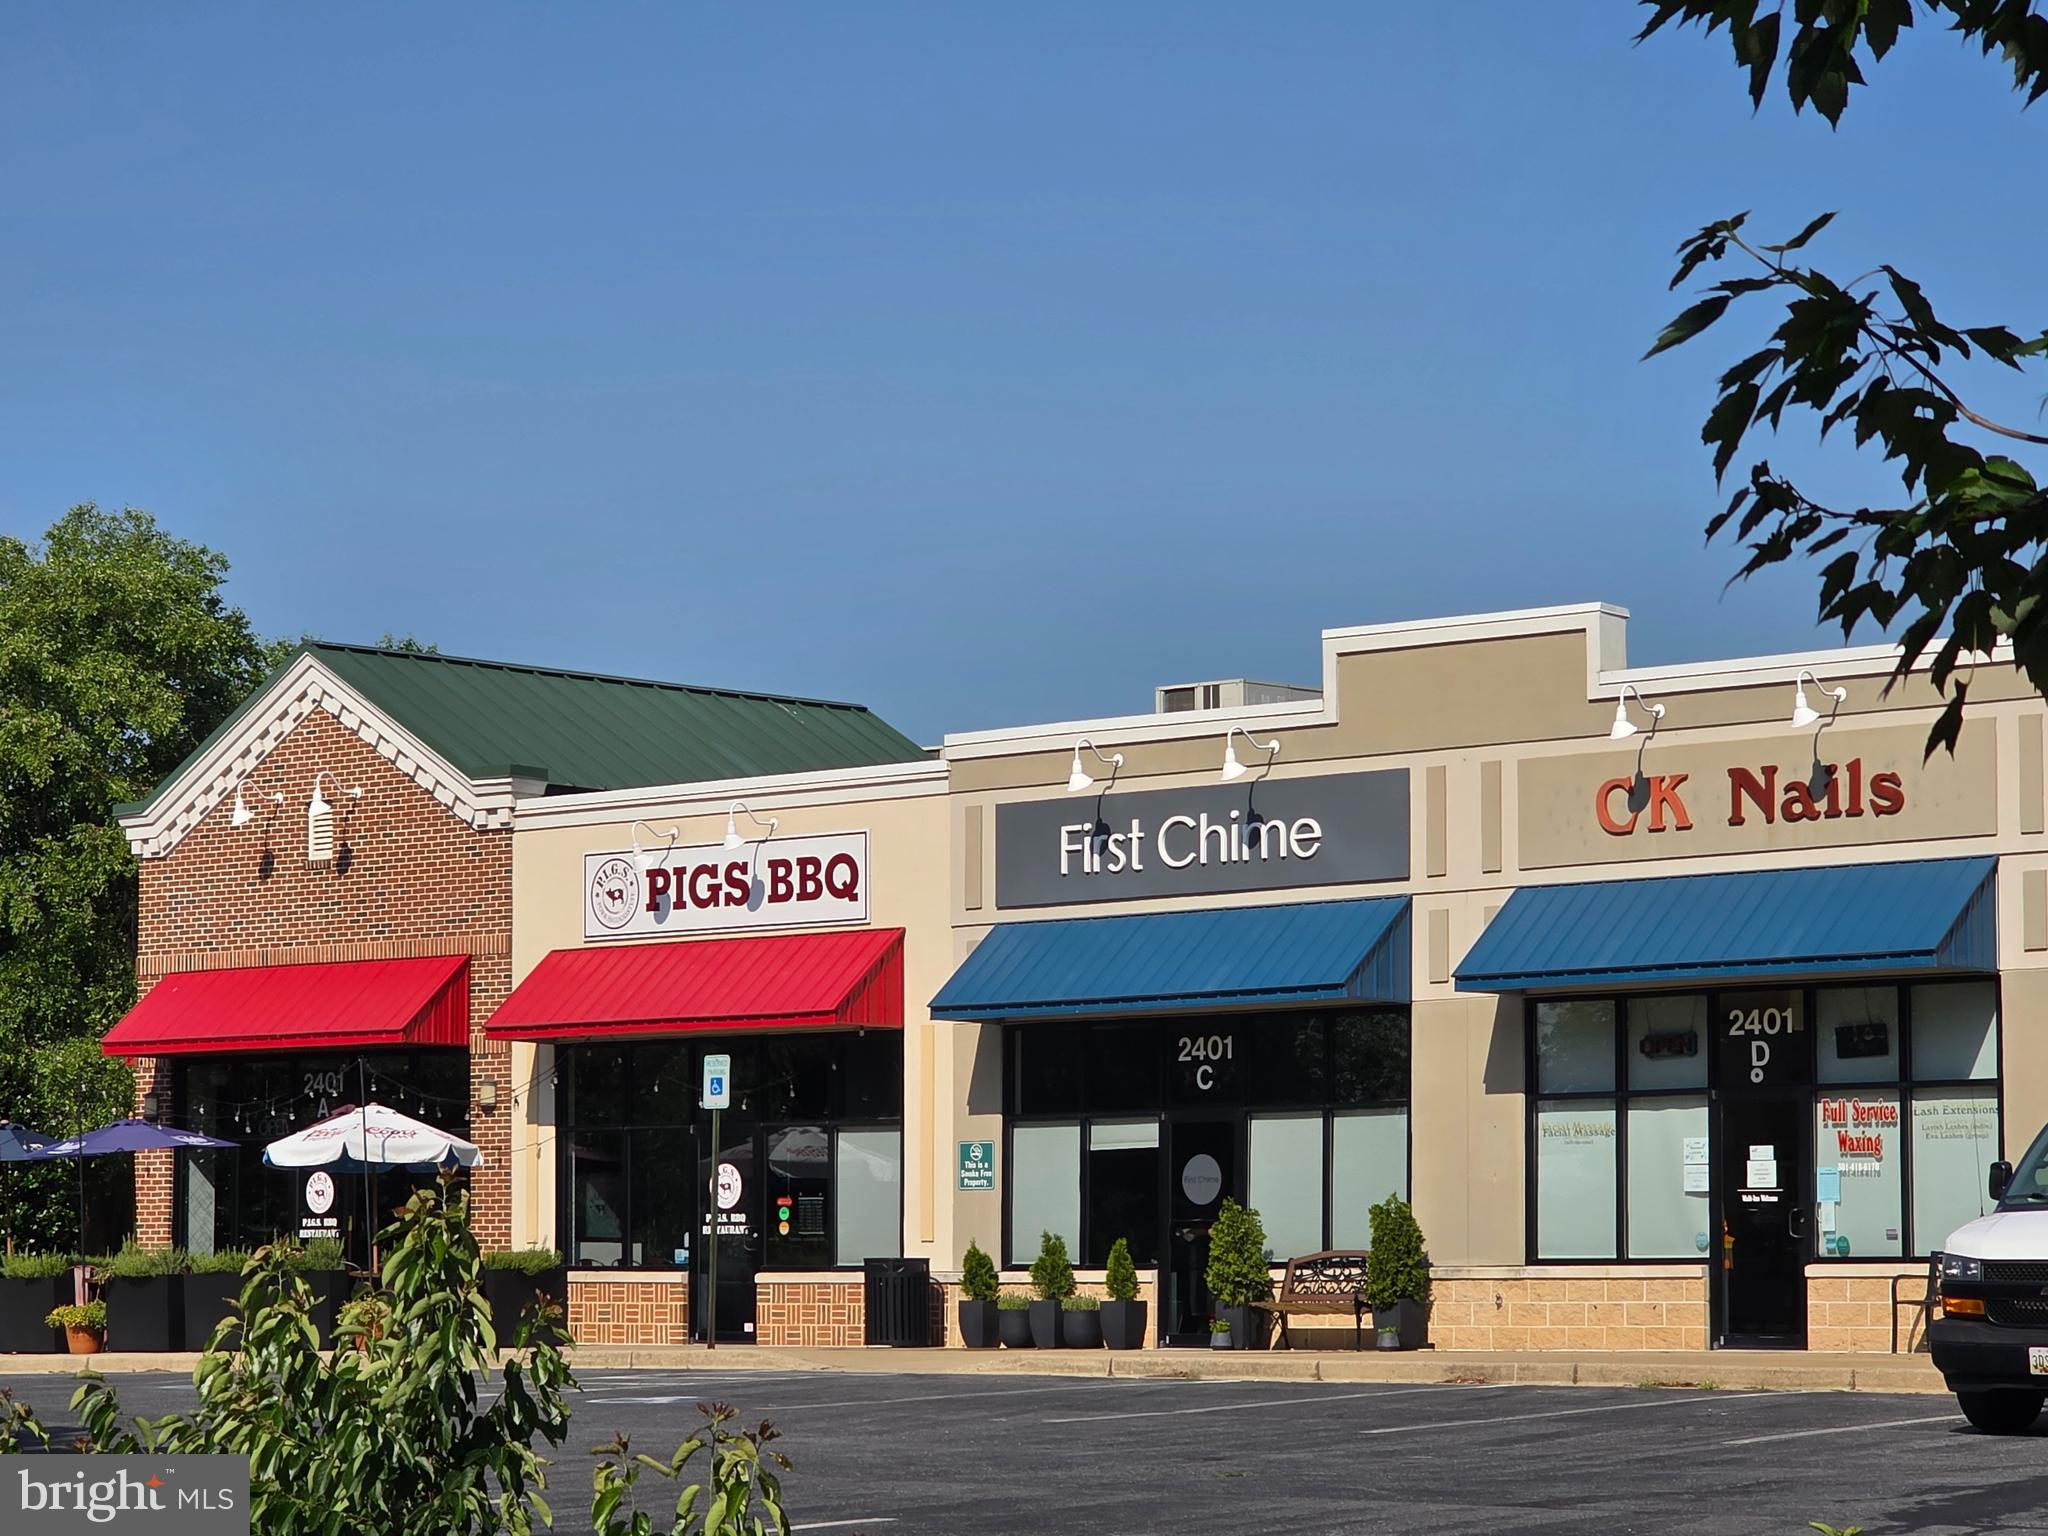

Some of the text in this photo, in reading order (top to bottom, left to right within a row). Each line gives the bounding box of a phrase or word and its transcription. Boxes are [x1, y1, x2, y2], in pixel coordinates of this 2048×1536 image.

[1595, 757, 1905, 836] CK Nails
[1060, 810, 1322, 875] First Chime
[596, 863, 630, 888] P.I.G.S.
[645, 861, 751, 912] PIGS
[767, 853, 859, 903] BBQ
[1729, 1008, 1793, 1036] 2401
[1178, 1035, 1232, 1062] 2401
[1752, 1041, 1770, 1066] D
[304, 1071, 344, 1094] 2401
[1196, 1064, 1214, 1090] C
[318, 1097, 330, 1118] A
[1822, 1098, 1898, 1123] Full Service
[1914, 1105, 1939, 1116] Lash
[1542, 1121, 1615, 1137] Facial Massage
[1837, 1130, 1883, 1157] Waxing
[964, 1178, 989, 1187] Property.
[980, 1169, 992, 1177] Free
